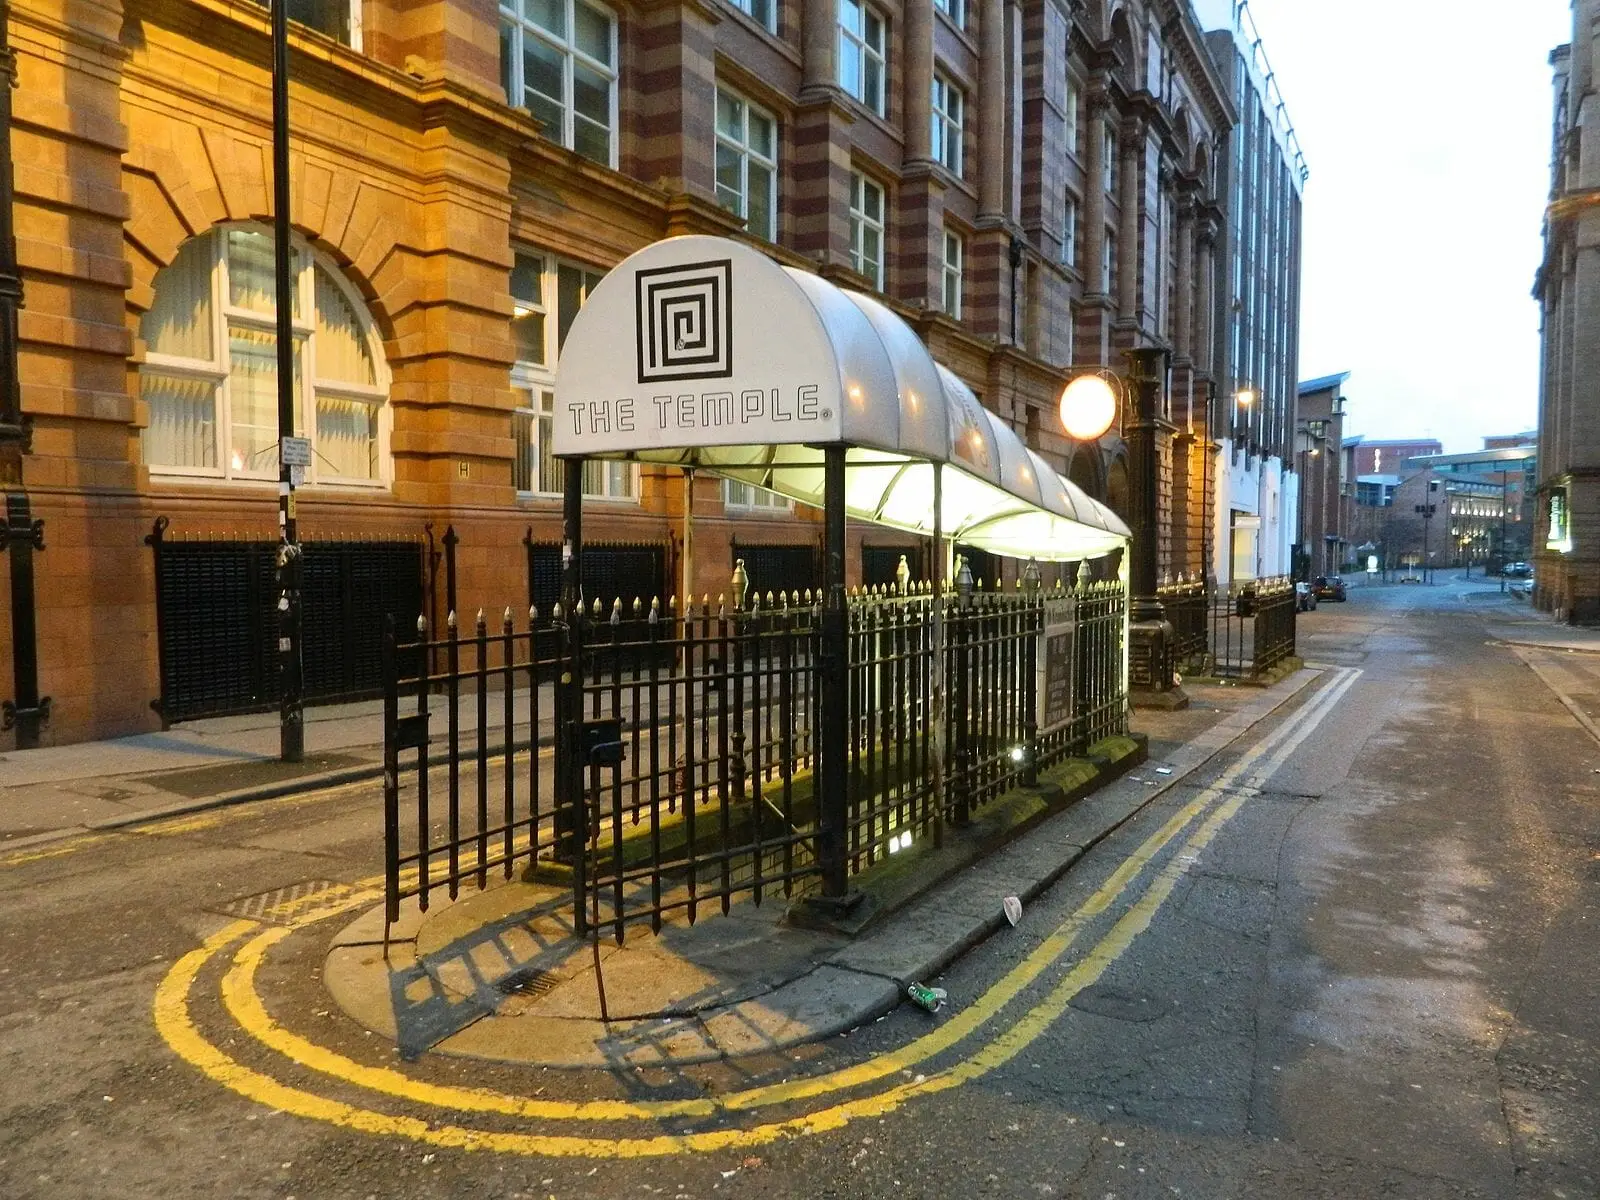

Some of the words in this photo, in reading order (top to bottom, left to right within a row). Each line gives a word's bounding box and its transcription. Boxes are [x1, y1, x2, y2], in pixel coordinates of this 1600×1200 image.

[568, 398, 635, 435] THE
[652, 384, 819, 429] TEMPLE
[459, 461, 469, 478] H
